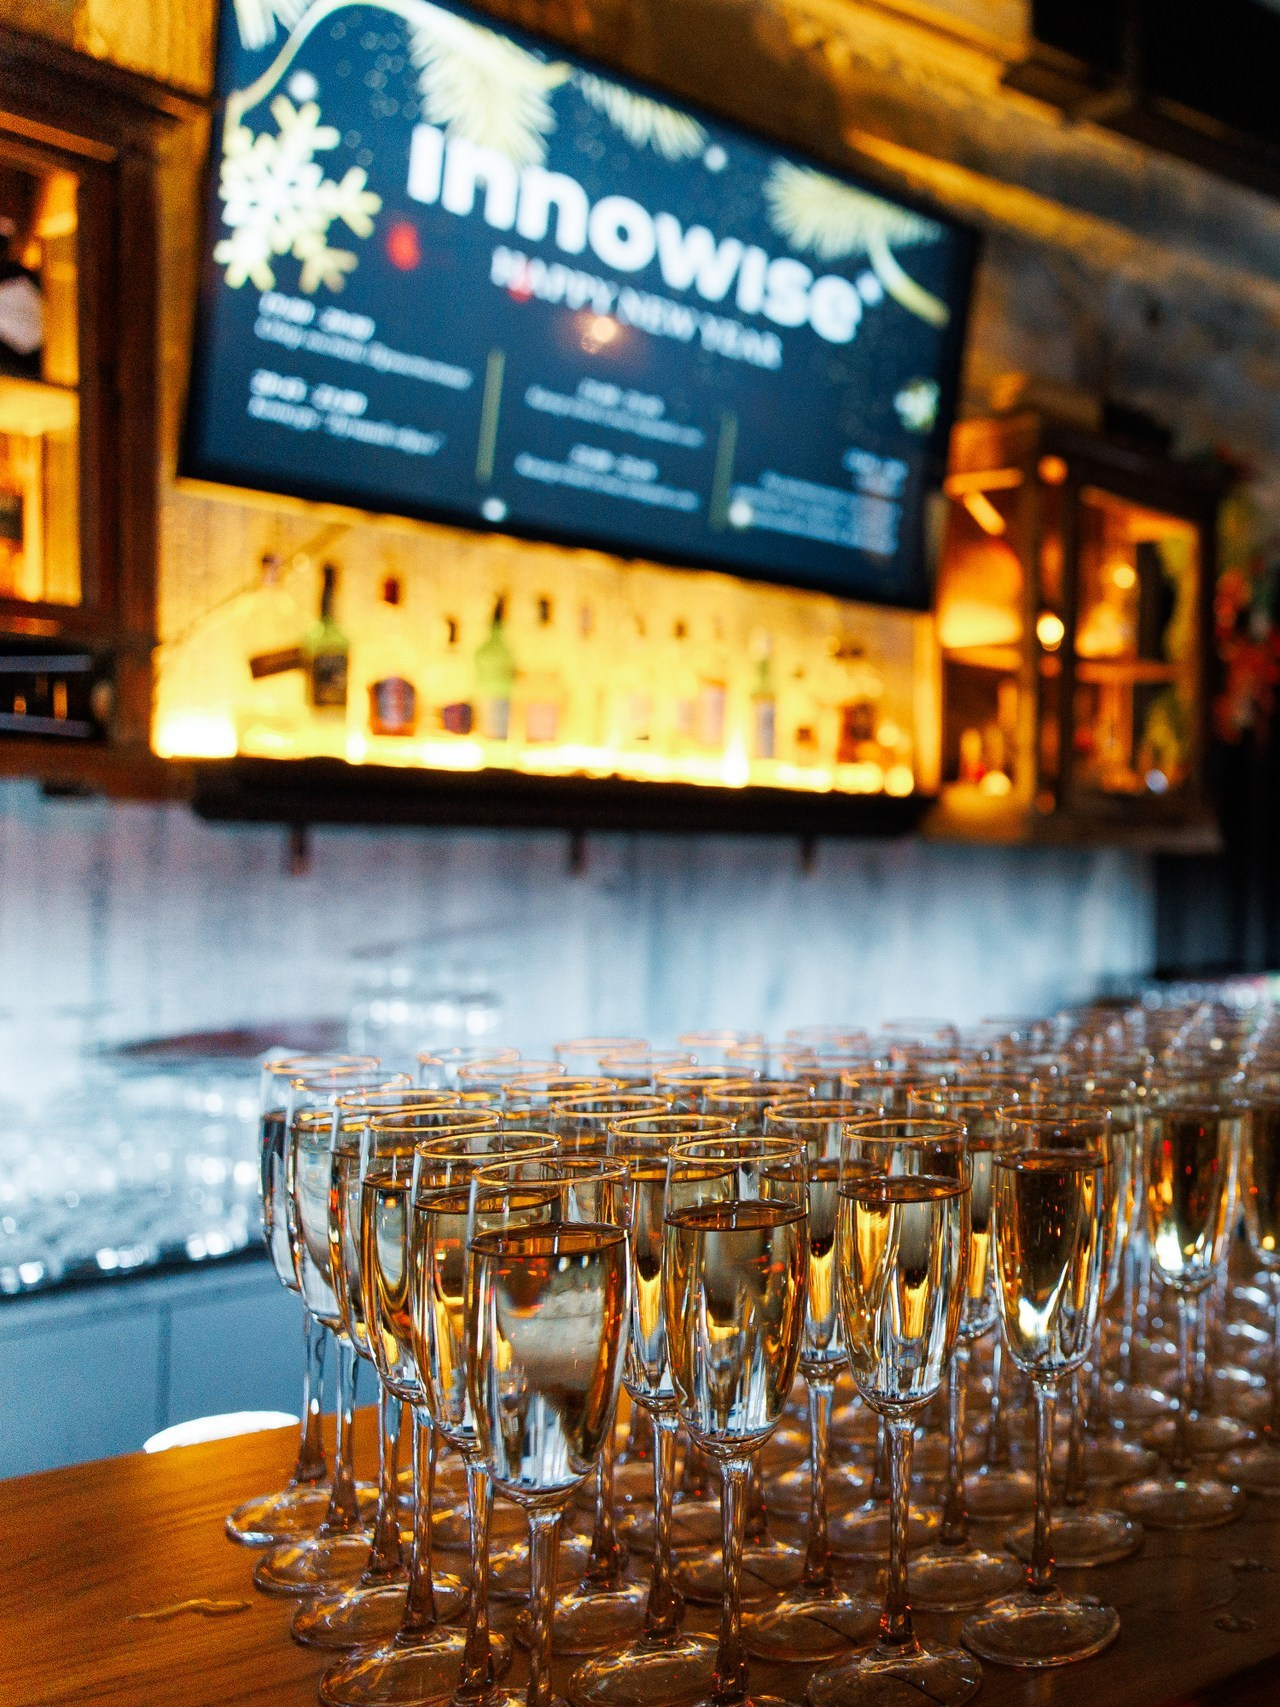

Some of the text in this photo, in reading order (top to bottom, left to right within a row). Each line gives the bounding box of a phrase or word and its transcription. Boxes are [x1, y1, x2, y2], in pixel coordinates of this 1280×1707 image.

[490, 245, 784, 371] HAPPY NEW YEAR
